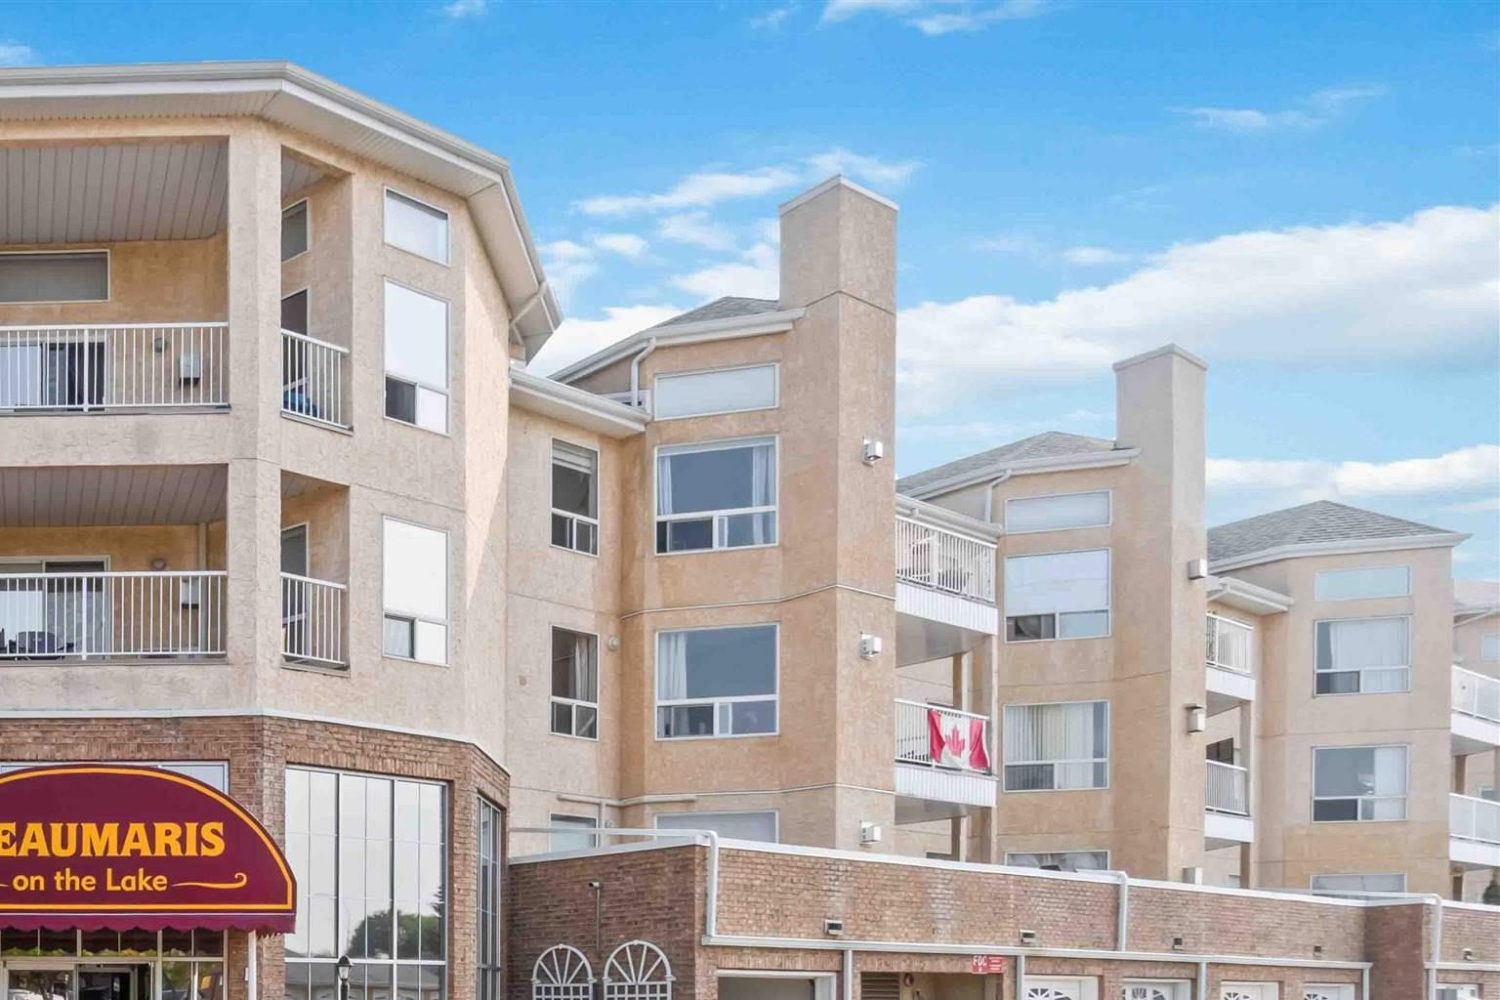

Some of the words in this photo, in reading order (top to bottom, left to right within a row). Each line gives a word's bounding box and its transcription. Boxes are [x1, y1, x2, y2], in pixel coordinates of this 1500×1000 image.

[12, 874, 45, 891] on
[53, 867, 97, 892] the
[106, 867, 168, 892] Lake
